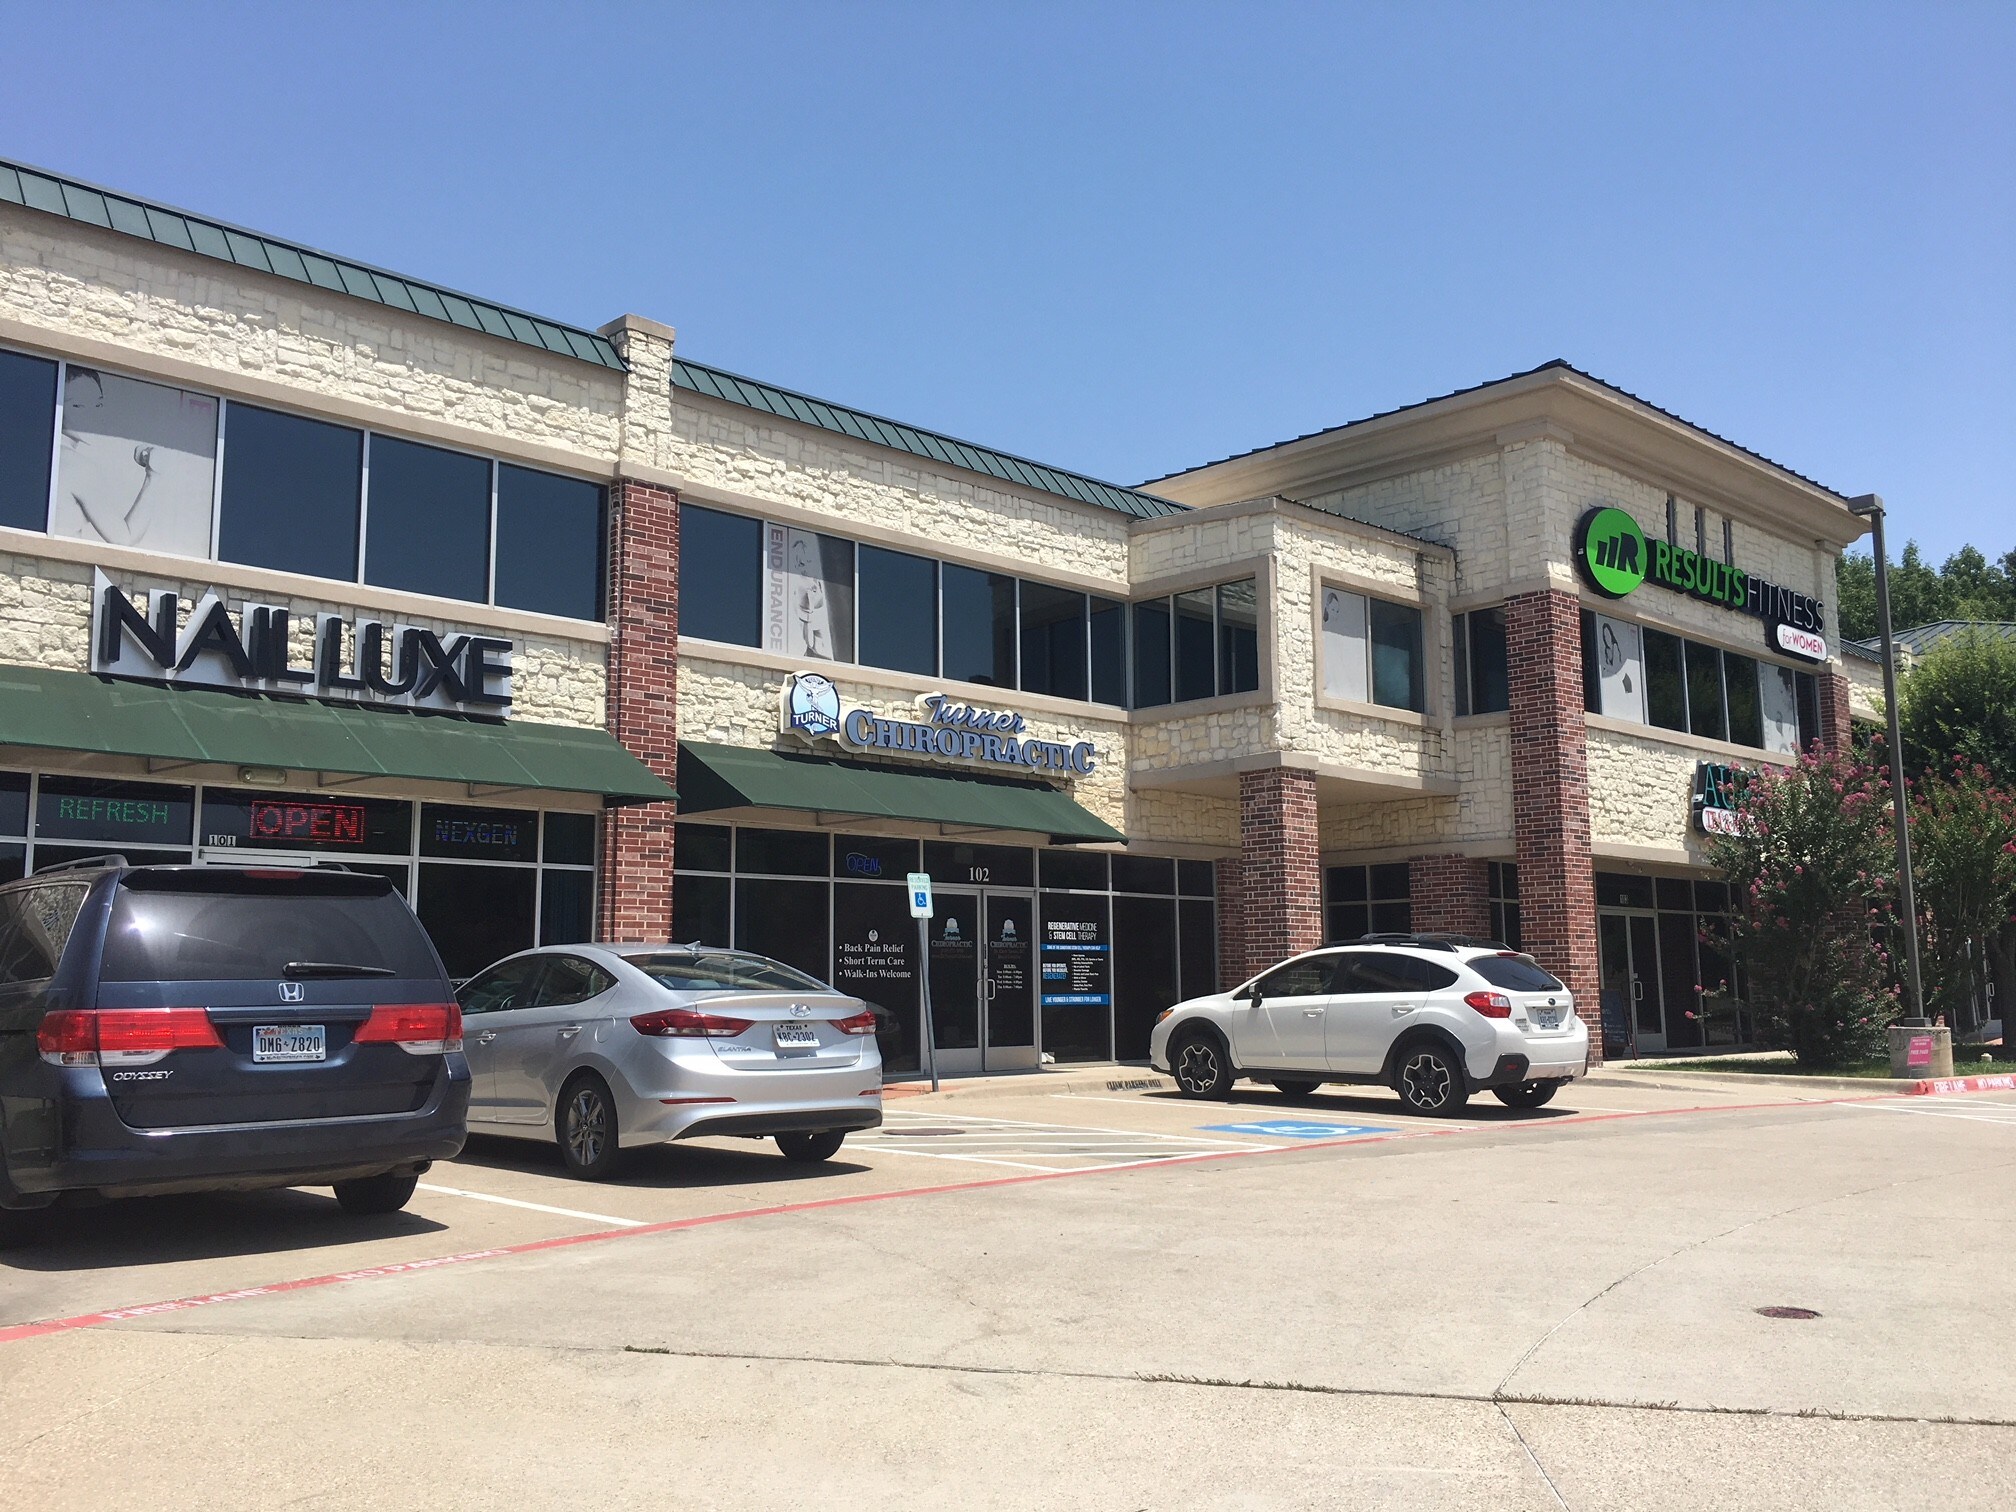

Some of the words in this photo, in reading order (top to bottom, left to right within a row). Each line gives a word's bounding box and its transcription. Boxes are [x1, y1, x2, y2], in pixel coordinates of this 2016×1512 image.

[769, 527, 784, 651] ENDURANCE
[1655, 539, 1745, 607] RESULTS
[1747, 574, 1826, 634] FITNESS
[100, 583, 315, 684] NAIL
[324, 615, 513, 706] LUXE
[1792, 633, 1824, 655] WOMEN
[791, 712, 839, 732] TURNER
[924, 693, 1026, 734] Turner
[845, 708, 1096, 775] CHIROPRACTIC
[59, 798, 169, 824] REFRESH
[257, 804, 358, 839] OPEN
[209, 833, 237, 847] 101
[435, 819, 519, 846] NEXGEN
[846, 855, 880, 872] OPEN
[968, 866, 990, 882] 102
[1066, 931, 1077, 940] CELL
[844, 943, 863, 953] Back
[864, 943, 881, 953] Pain
[882, 943, 905, 953] Relief
[843, 956, 865, 966] Short
[866, 956, 886, 966] Term
[887, 956, 905, 966] Care
[843, 969, 878, 978] Walk-Ins
[878, 969, 912, 978] Welcome
[291, 1036, 320, 1052] Z820
[112, 1070, 175, 1082] ODYSSEY
[1933, 1081, 1949, 1095] FIRE
[1948, 1080, 1968, 1094] LANE
[1976, 1078, 1987, 1089] NO
[1987, 1076, 2015, 1090] PARKING
[101, 1301, 188, 1320] FIRE
[184, 1286, 278, 1306] LANE
[335, 1269, 386, 1280] NO
[383, 1249, 513, 1271] PARKING
